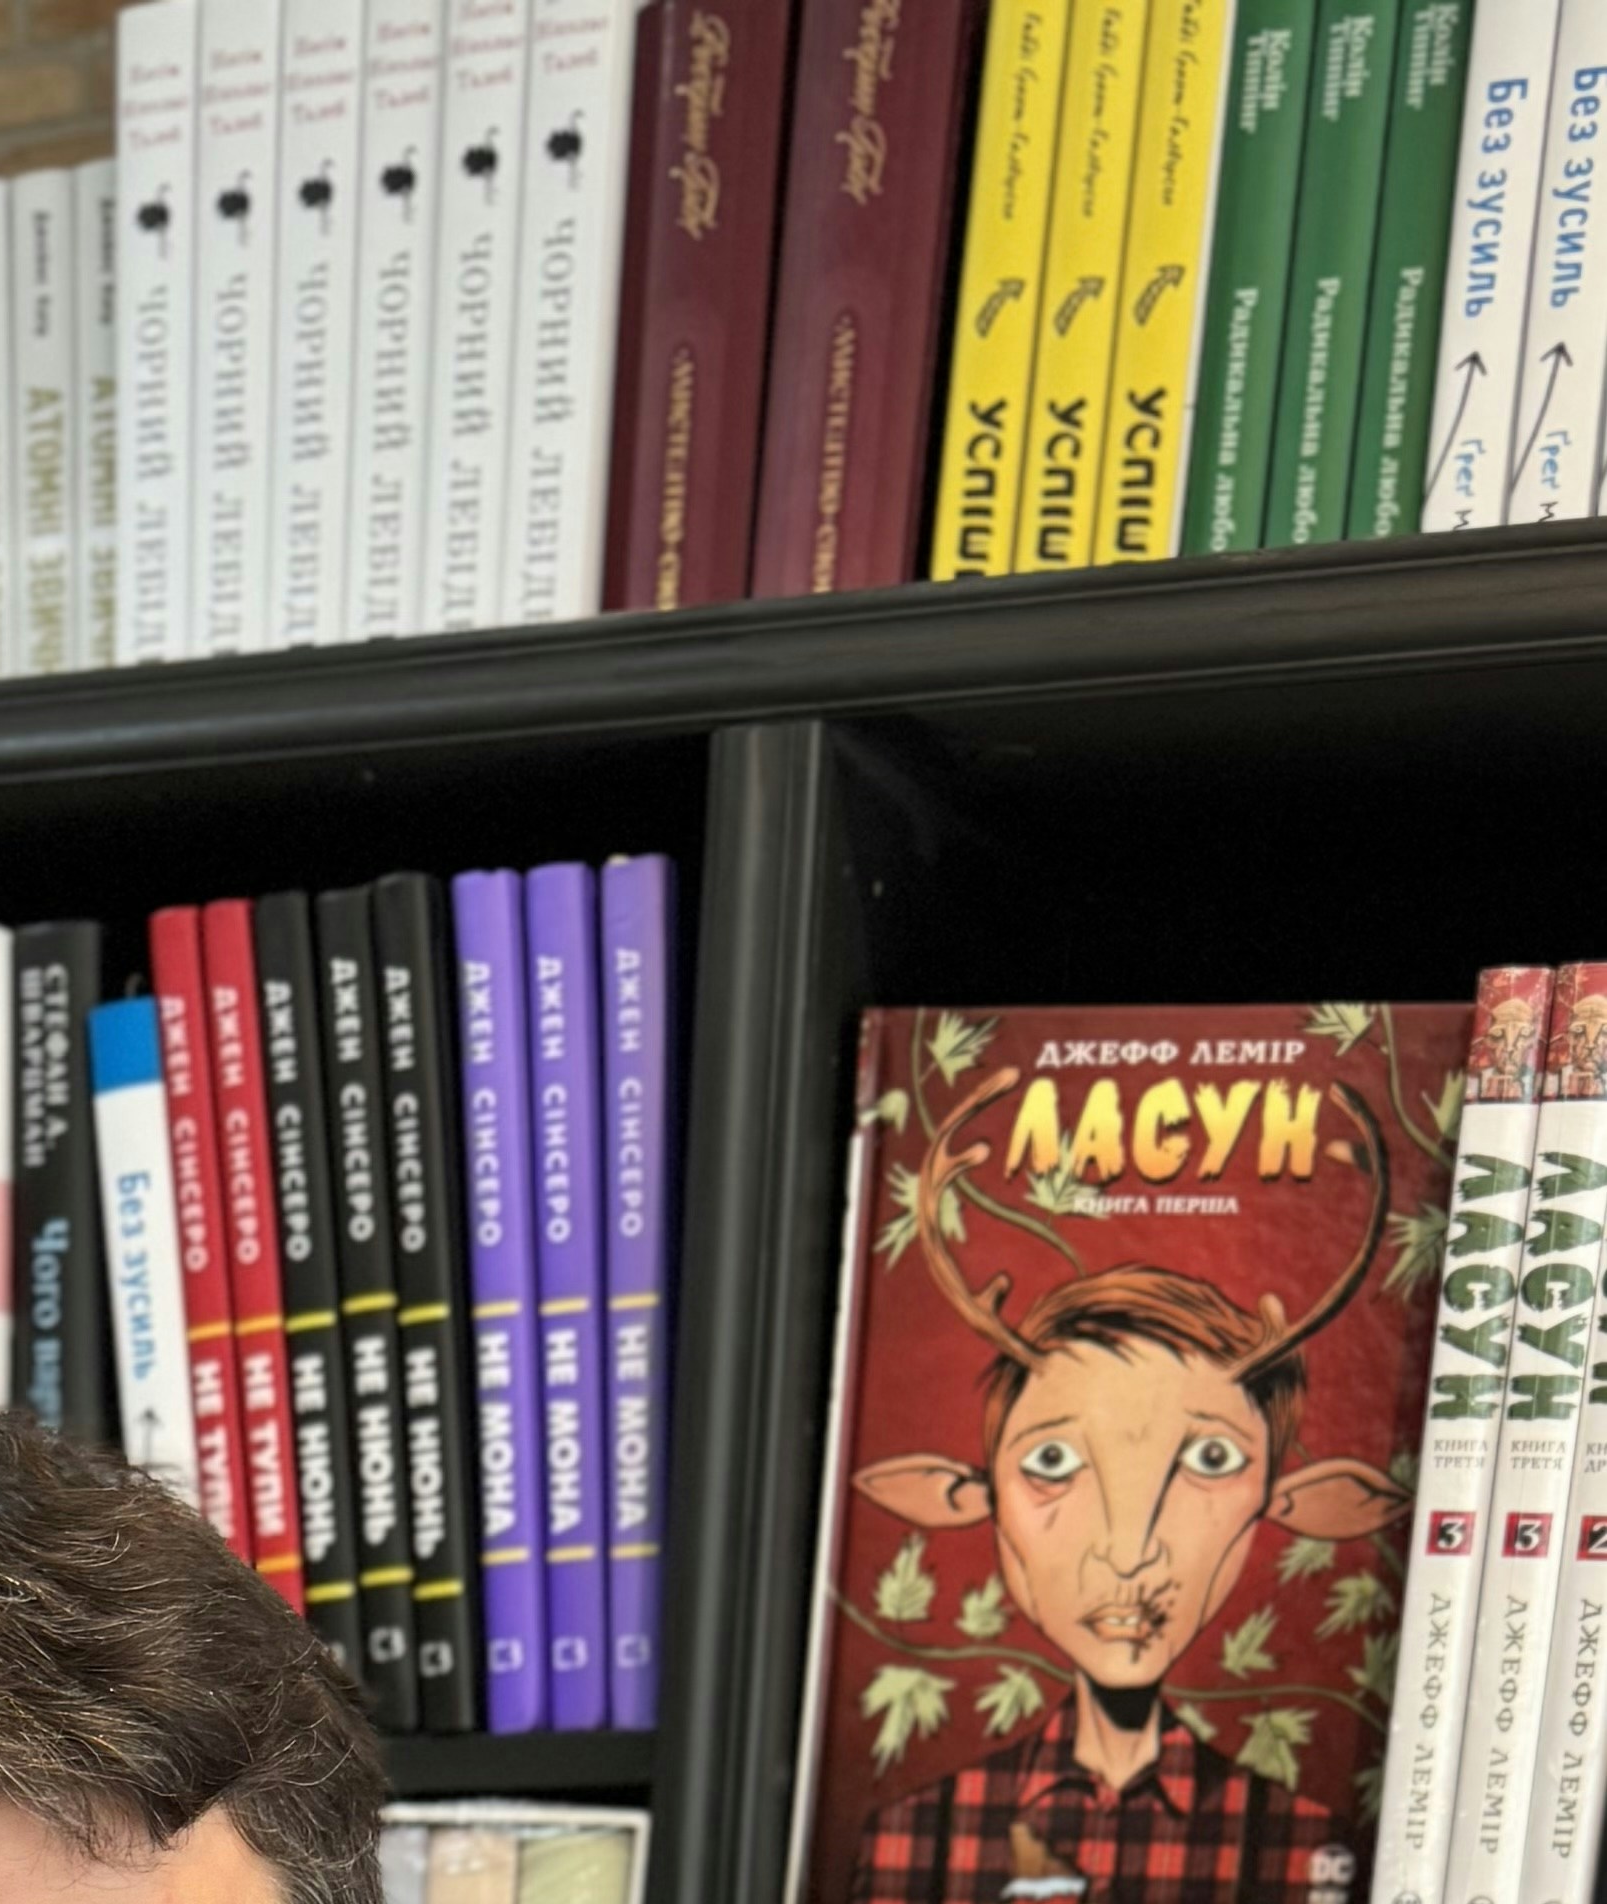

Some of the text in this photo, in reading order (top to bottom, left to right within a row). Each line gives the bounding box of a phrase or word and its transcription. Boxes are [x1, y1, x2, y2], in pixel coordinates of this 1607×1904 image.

[1465, 77, 1528, 319] Без зусиль
[1550, 67, 1607, 310] Без зусиль
[954, 398, 1007, 578] УСПІШ
[1037, 397, 1087, 570] УСПІШ
[1115, 388, 1166, 556] УСПІШ
[1211, 288, 1258, 552] Радикальна любо
[1294, 278, 1341, 545] Радикальна любо
[1376, 267, 1424, 537] Радикальна любо
[445, 461, 481, 632] ЛЕБІД
[522, 449, 562, 619] ЛЕБІД
[22, 969, 45, 1166] ШВАРЦМАН
[46, 965, 68, 1105] СТЕФАН
[160, 995, 208, 1273] ДЖЕН СІНСЕРО
[213, 986, 260, 1265] ДЖЕН СІНСЕРО
[265, 981, 310, 1261] ДЖЕН СІНСЕРО
[331, 958, 374, 1243] ДЖЕН СІНСЕРО
[385, 966, 425, 1252] ДЖЕН СІНСЕРО
[463, 960, 503, 1247] ДЖЕН СІНСЕРО
[538, 957, 572, 1243] ДЖЕН СІНСЕРО
[617, 949, 643, 1237] ДЖЕН СІНСЕРО
[1005, 1077, 1321, 1184] ЛАСУН
[1035, 1040, 1305, 1069] ДЖЕФФ ЛЕМІР
[31, 1220, 68, 1327] Чого
[118, 1171, 157, 1380] Без зусиль
[1073, 1195, 1239, 1215] КНИГА ПЕРША
[1430, 1153, 1531, 1420] ЛАСУН
[1507, 1151, 1607, 1420] ЛАСУН
[193, 1361, 235, 1540] НЕ ТУПИ
[243, 1354, 286, 1537] НЕ ТУПИ
[294, 1355, 336, 1562] НЕ НЮНЬ
[354, 1337, 395, 1545] НЕ НЮНЬ
[406, 1349, 447, 1558] НЕ НЮНЬ
[478, 1333, 516, 1537] НЕ МОНА
[546, 1329, 580, 1534] НЕ МОНА
[616, 1326, 649, 1531] НЕ МОНА
[1434, 1439, 1488, 1452] КНИГА
[1434, 1455, 1485, 1469] ТРЕТЯ
[1511, 1440, 1567, 1454] КНИГА
[1511, 1455, 1563, 1470] ТРЕТЯ
[1438, 1517, 1467, 1547] 3
[1516, 1519, 1544, 1549] 3
[1406, 1592, 1451, 1850] ДЖЕФФ ЛЕМІР
[1480, 1594, 1528, 1854] ДЖЕФФ ЛЕМІР
[1553, 1599, 1603, 1859] ДЖЕФФ ЛЕМІР
